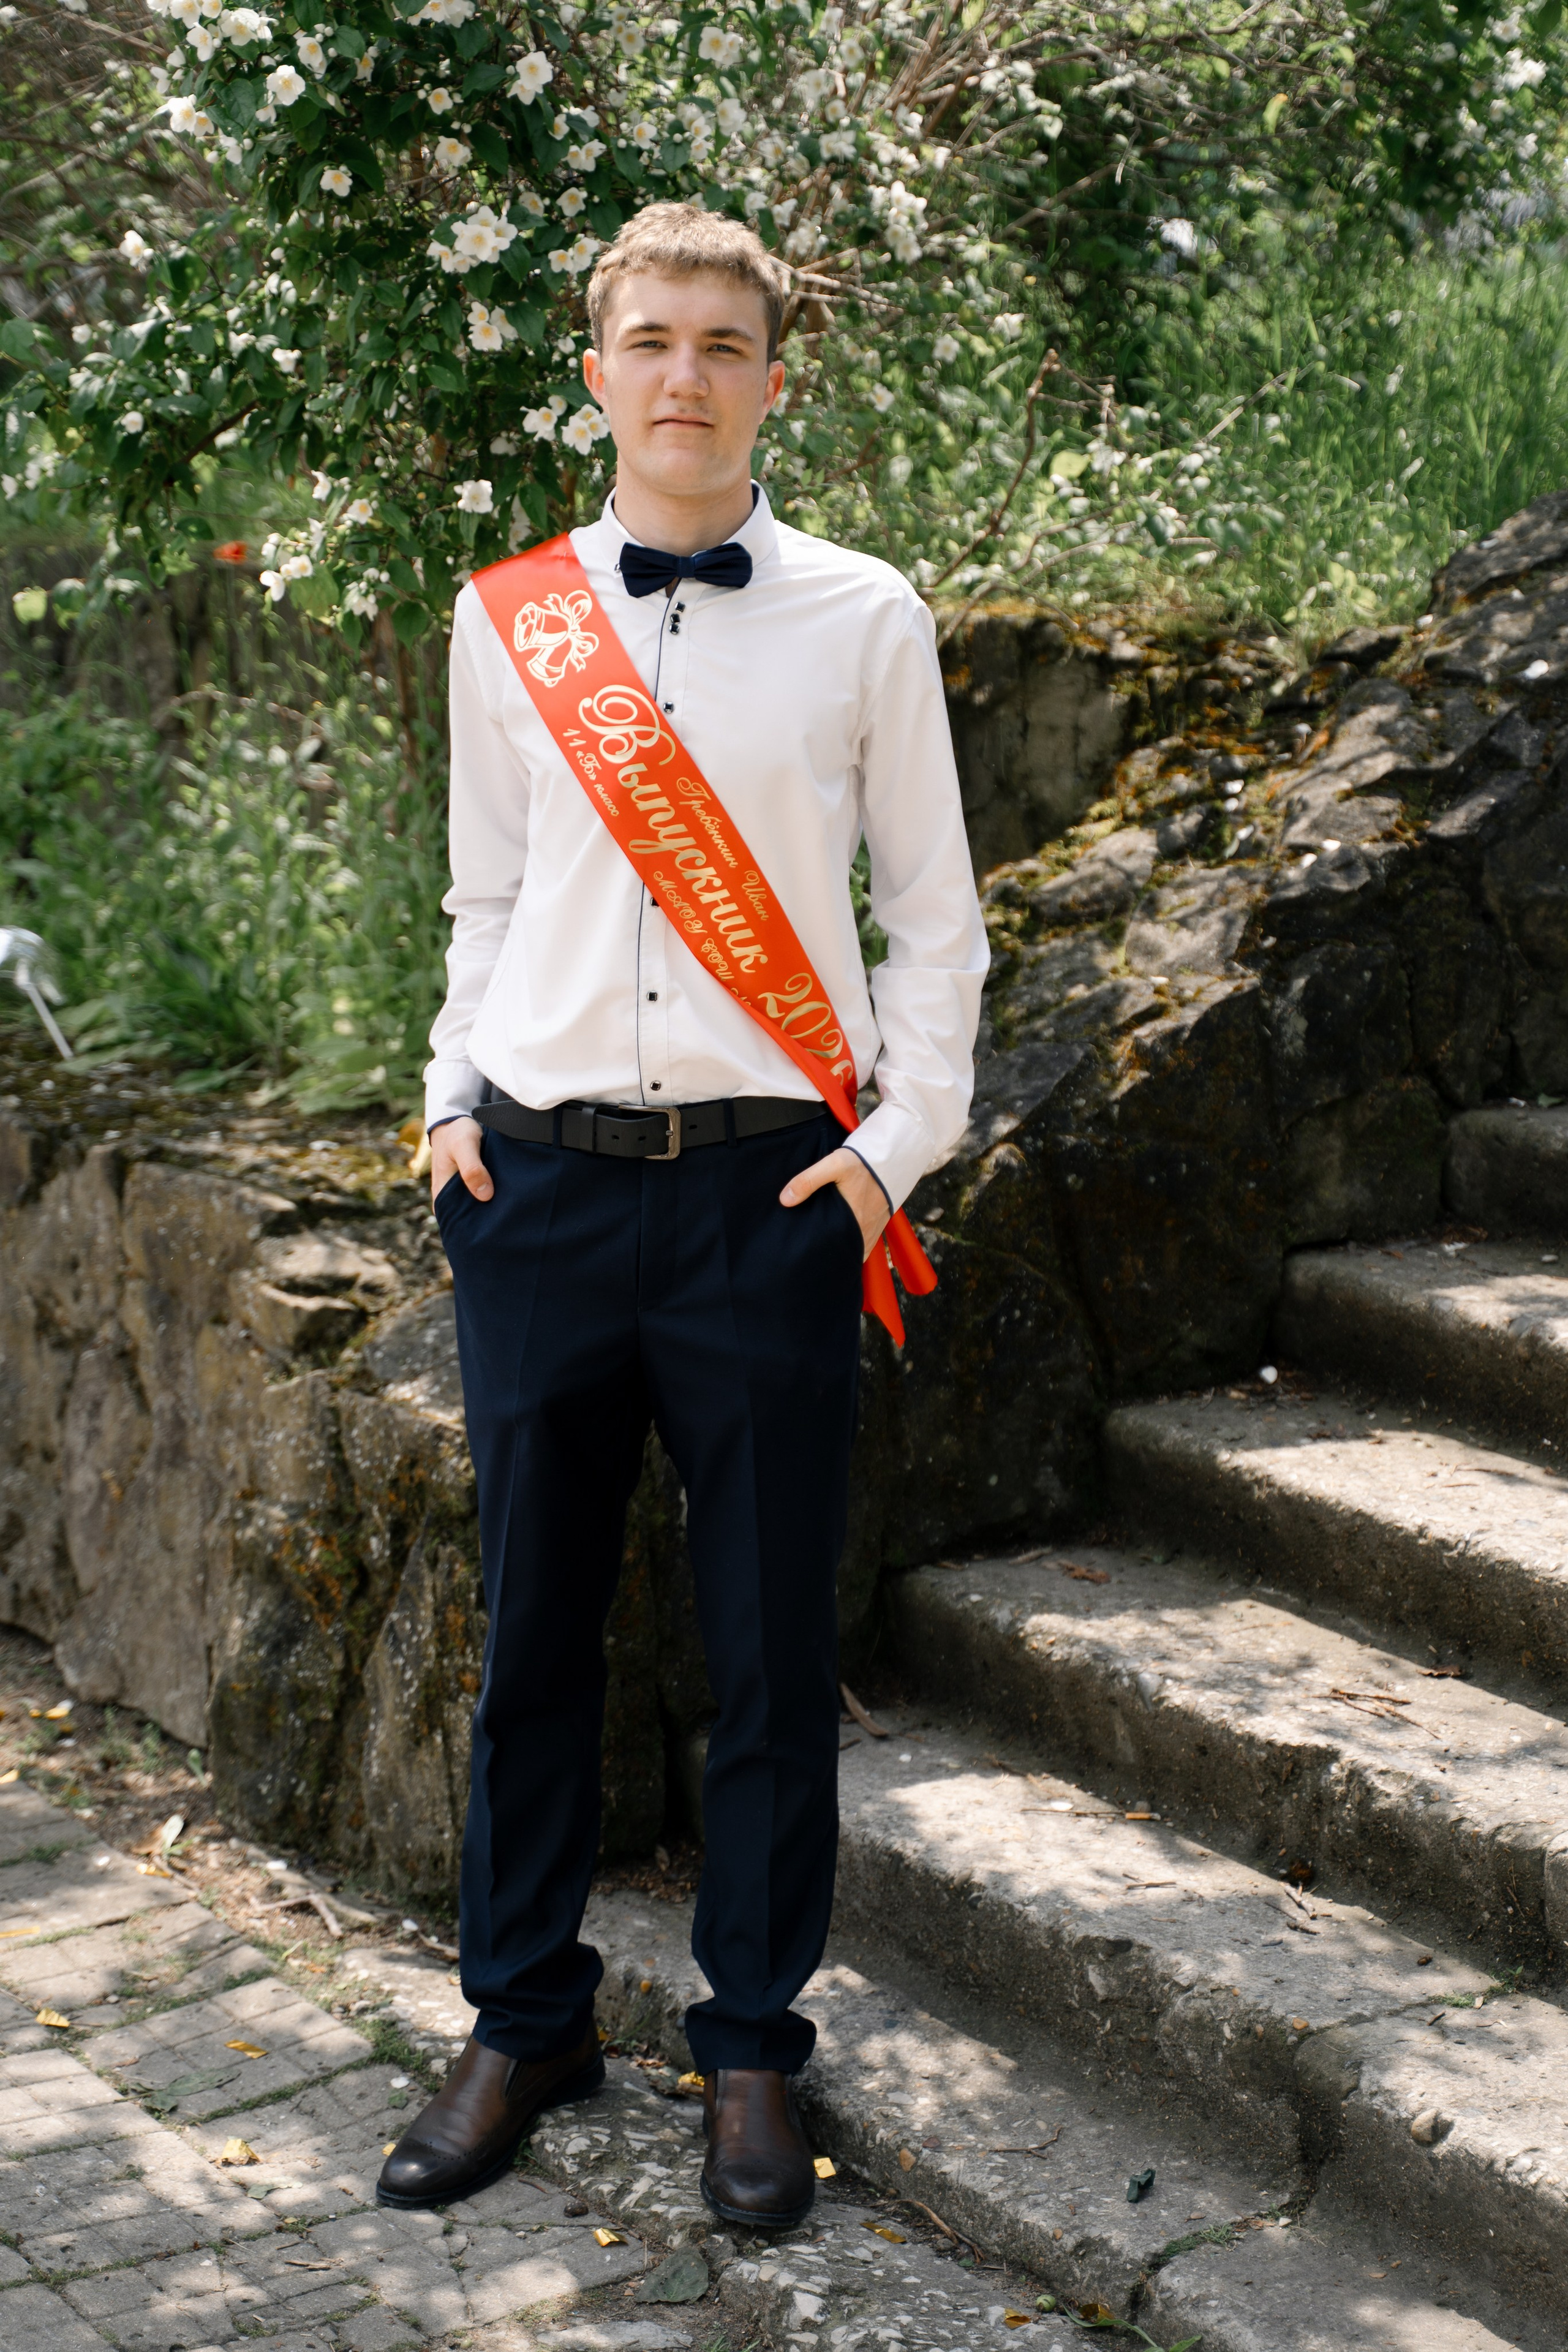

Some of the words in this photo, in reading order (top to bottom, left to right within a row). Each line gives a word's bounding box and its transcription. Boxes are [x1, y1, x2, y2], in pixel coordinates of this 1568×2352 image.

[562, 728, 587, 748] 11
[593, 783, 620, 817] класс
[578, 684, 769, 974] Выпускник
[676, 777, 739, 868] Гребёнкин
[741, 870, 769, 921] Иван
[653, 870, 708, 934] МАОУ
[701, 937, 735, 981] СОШ
